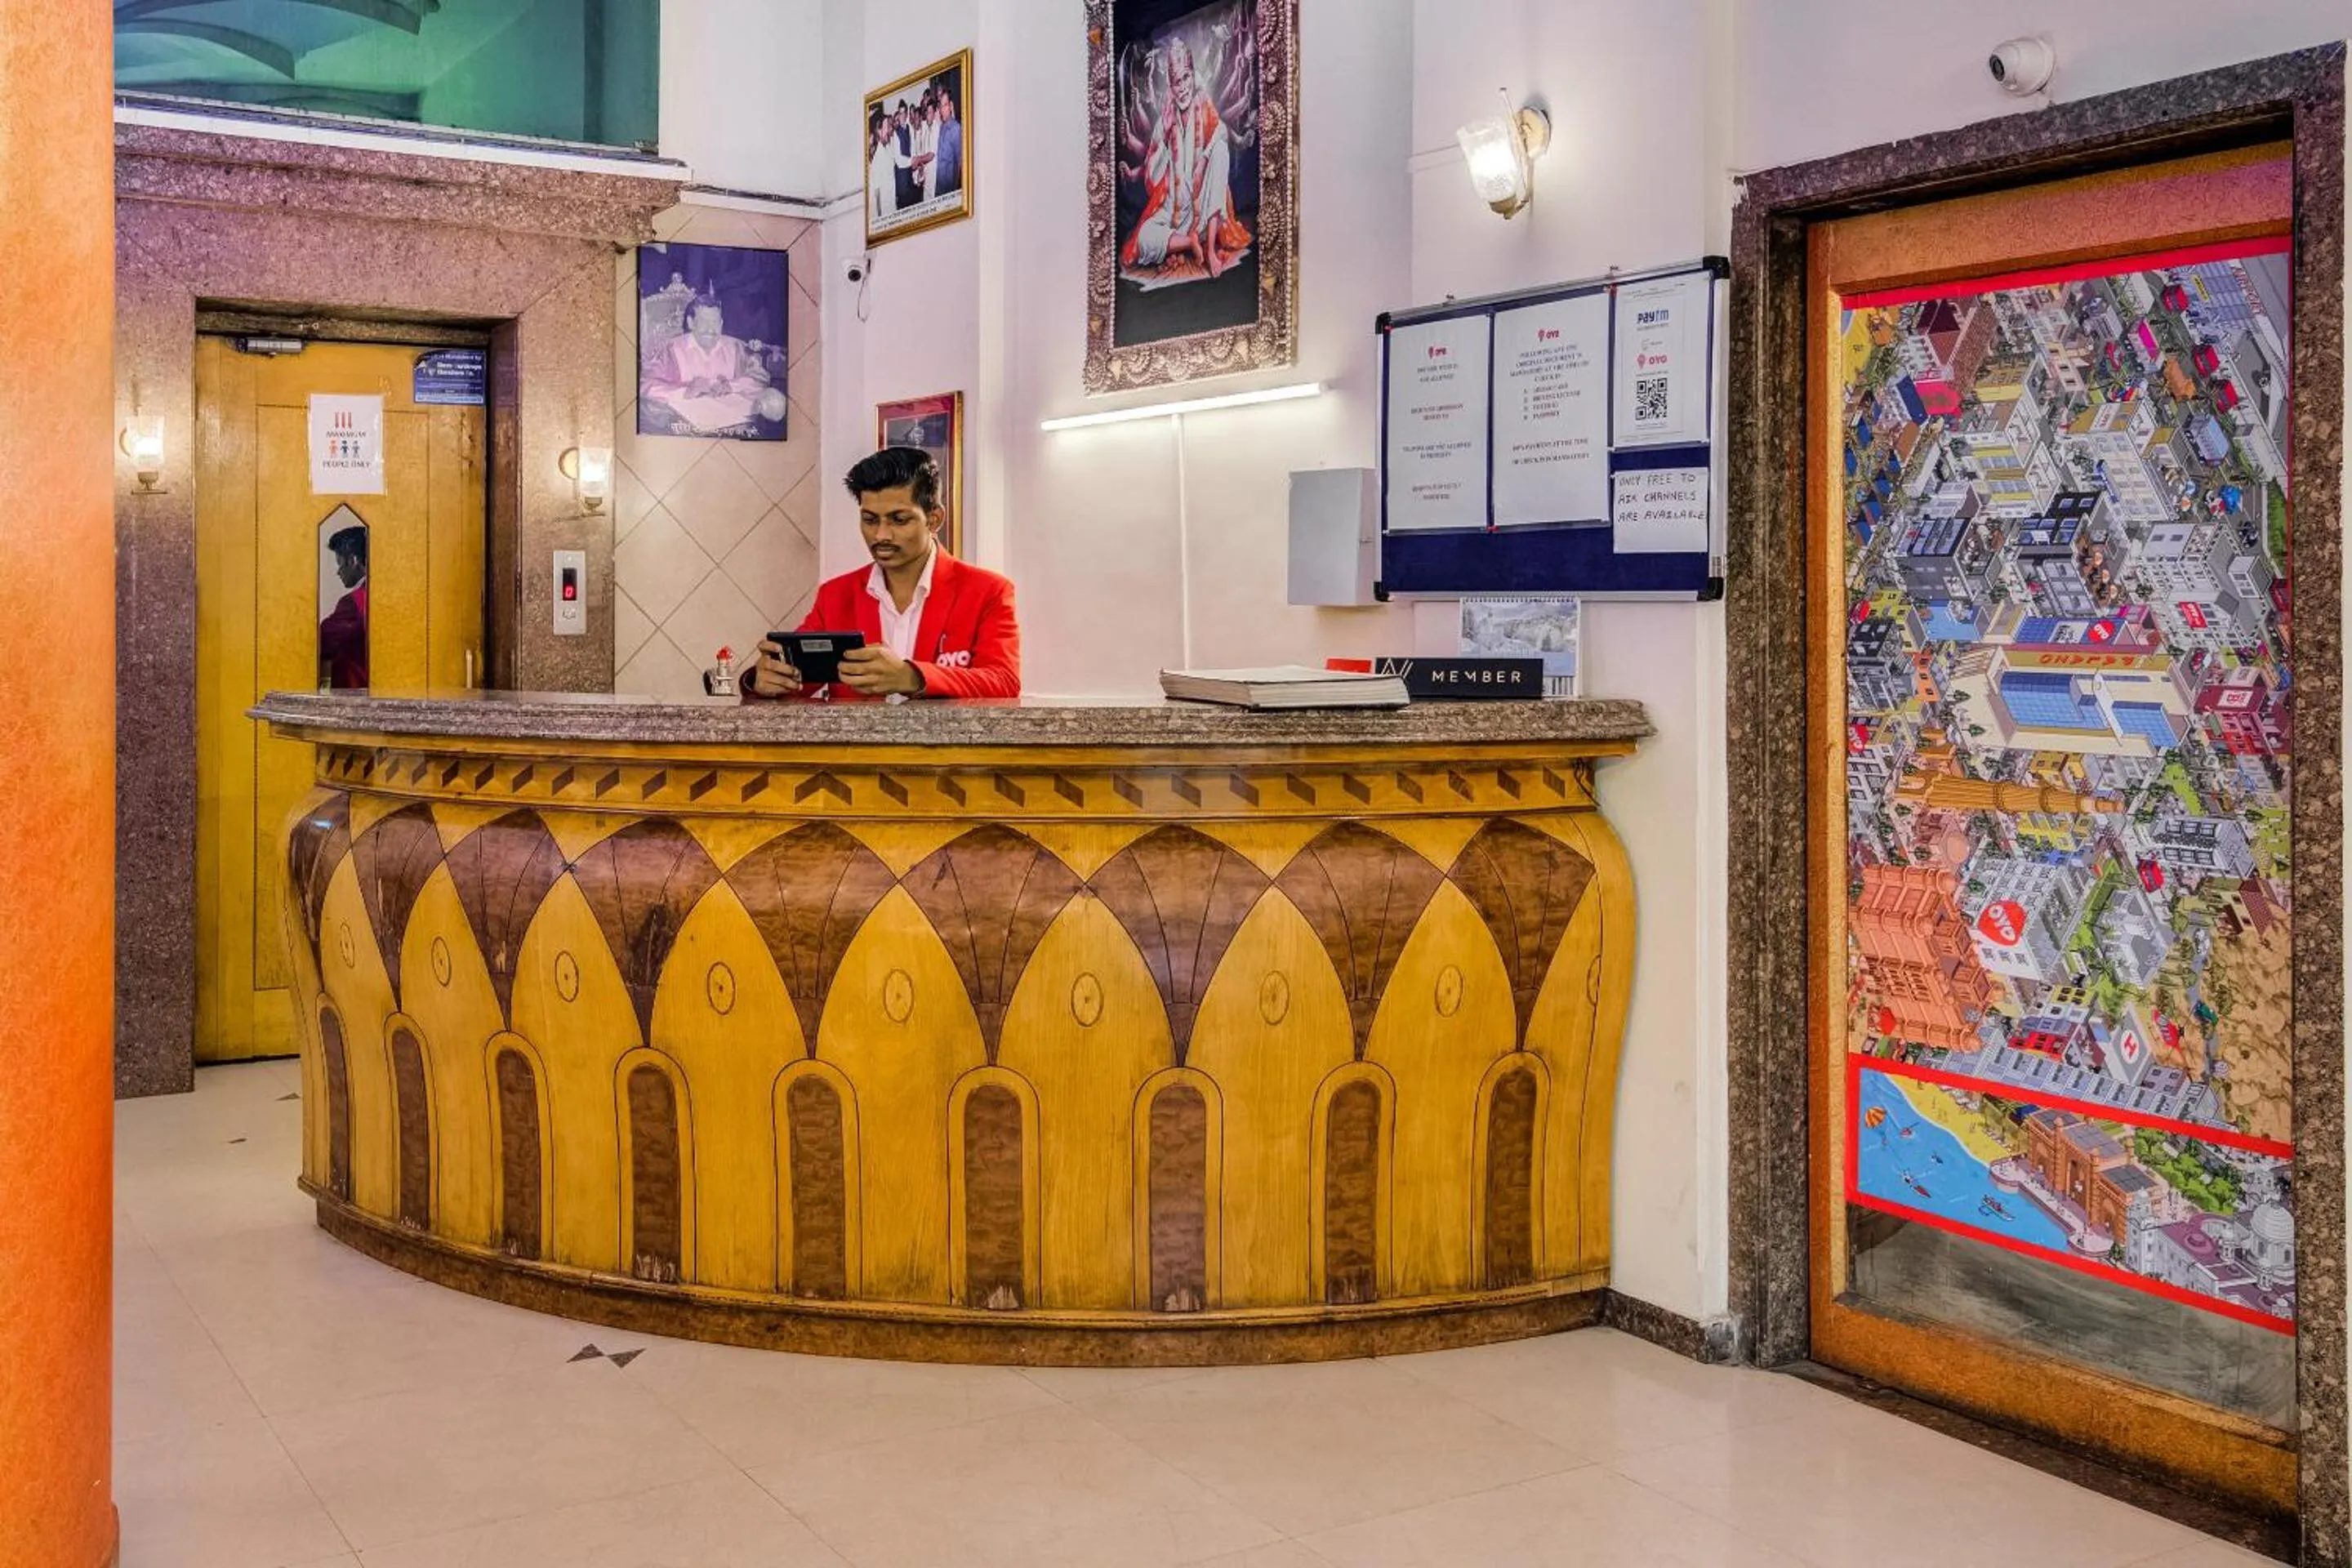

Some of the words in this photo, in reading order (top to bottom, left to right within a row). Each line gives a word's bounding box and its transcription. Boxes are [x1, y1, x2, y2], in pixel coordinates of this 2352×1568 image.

[1649, 355, 1668, 365] OYO
[1619, 475, 1641, 487] ONLY
[1648, 474, 1673, 485] FREE
[1681, 473, 1696, 483] TO
[1618, 494, 1637, 504] AIR
[1644, 491, 1697, 502] CHANNELS
[1618, 512, 1638, 523] ARE
[2094, 623, 2109, 639] OYO
[936, 650, 972, 668] OYO
[1432, 670, 1521, 684] MEMBER
[1988, 904, 2016, 942] OYO
